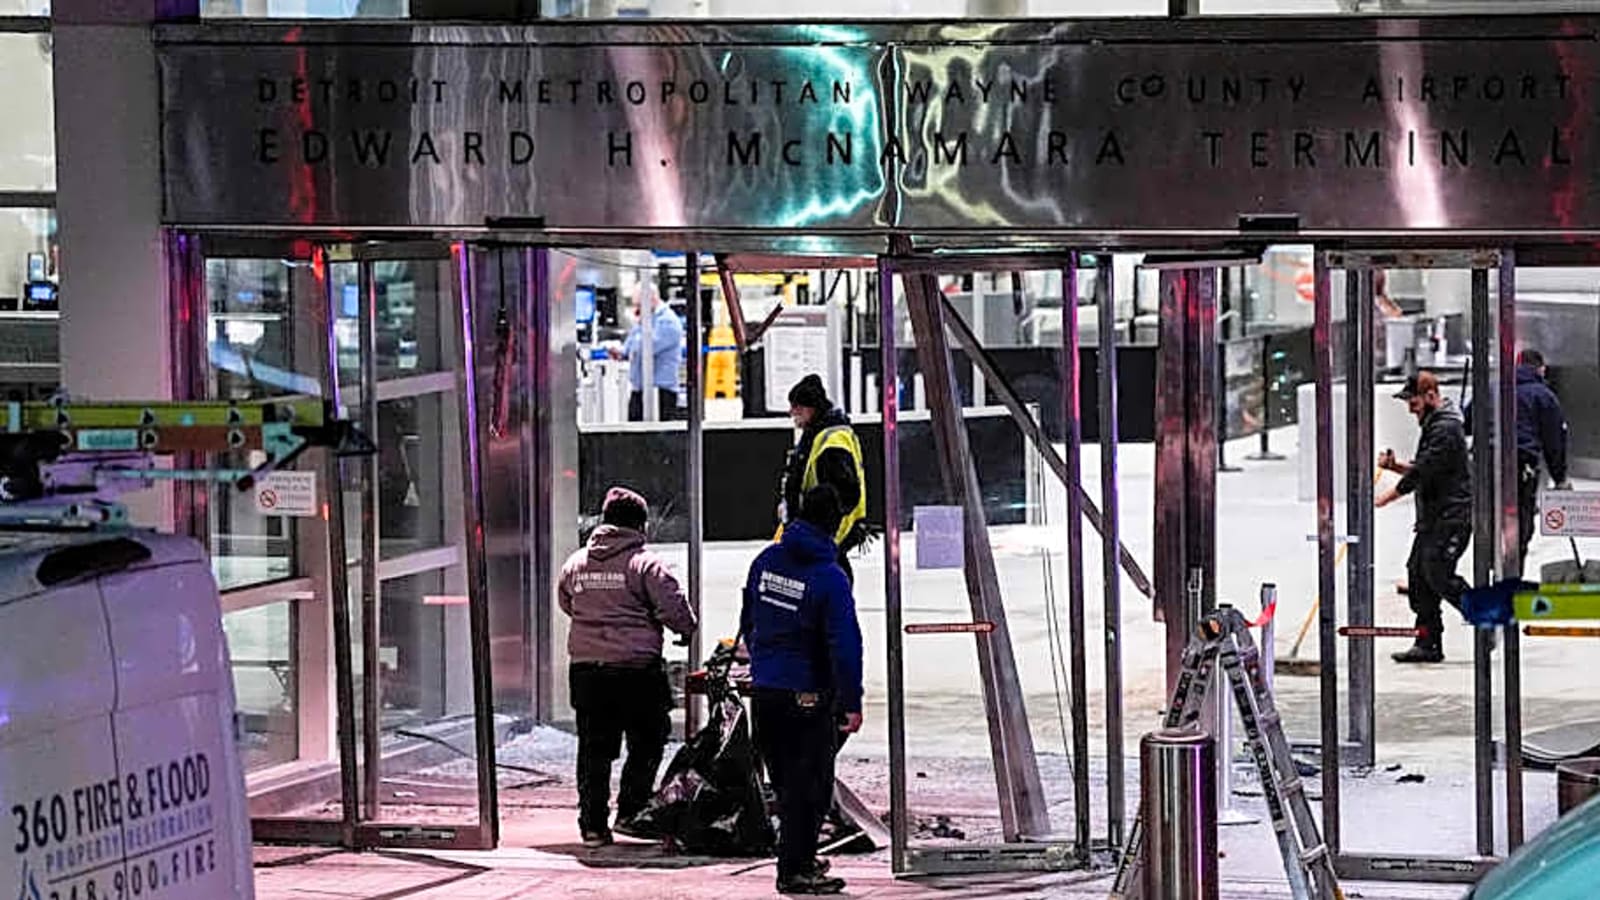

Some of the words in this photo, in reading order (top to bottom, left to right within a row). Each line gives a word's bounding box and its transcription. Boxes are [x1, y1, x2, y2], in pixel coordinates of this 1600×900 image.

[257, 80, 447, 103] DETROIT
[499, 78, 852, 105] METROPOLITAN
[904, 79, 1057, 104] WAYNE
[1116, 75, 1307, 104] COUNTY
[1362, 73, 1572, 104] AIRPORT
[258, 129, 536, 166] EDWARD
[607, 130, 668, 168] H.
[1202, 128, 1572, 168] TERMINAL
[11, 793, 68, 854] 360
[73, 779, 123, 836] FIRE
[126, 772, 143, 820] &
[146, 752, 211, 816] FLOOD
